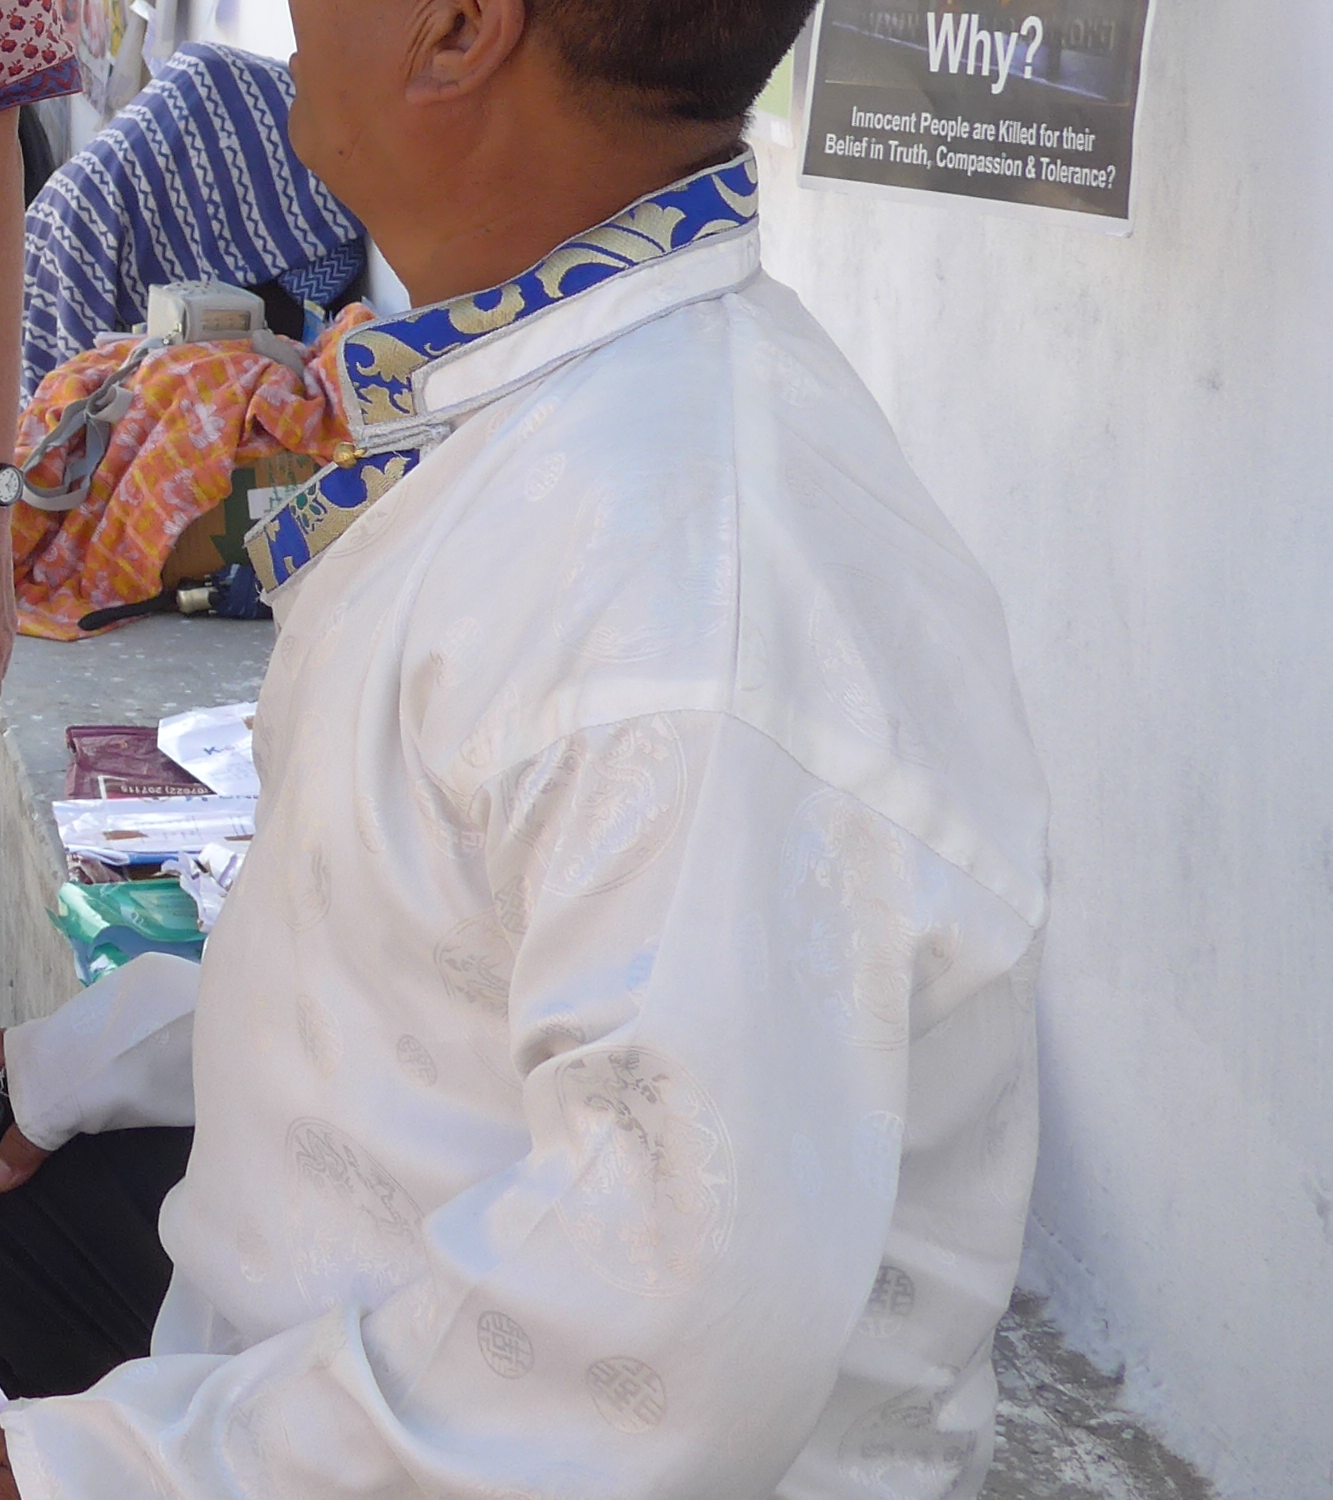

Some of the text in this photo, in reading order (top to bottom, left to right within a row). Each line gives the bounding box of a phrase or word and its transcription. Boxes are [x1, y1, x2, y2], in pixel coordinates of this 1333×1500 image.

[926, 11, 1044, 94] Why?
[851, 105, 1096, 152] Innocent People are Killed for their
[824, 133, 1116, 189] Belief in Truth, Compassion & Tolerance?
